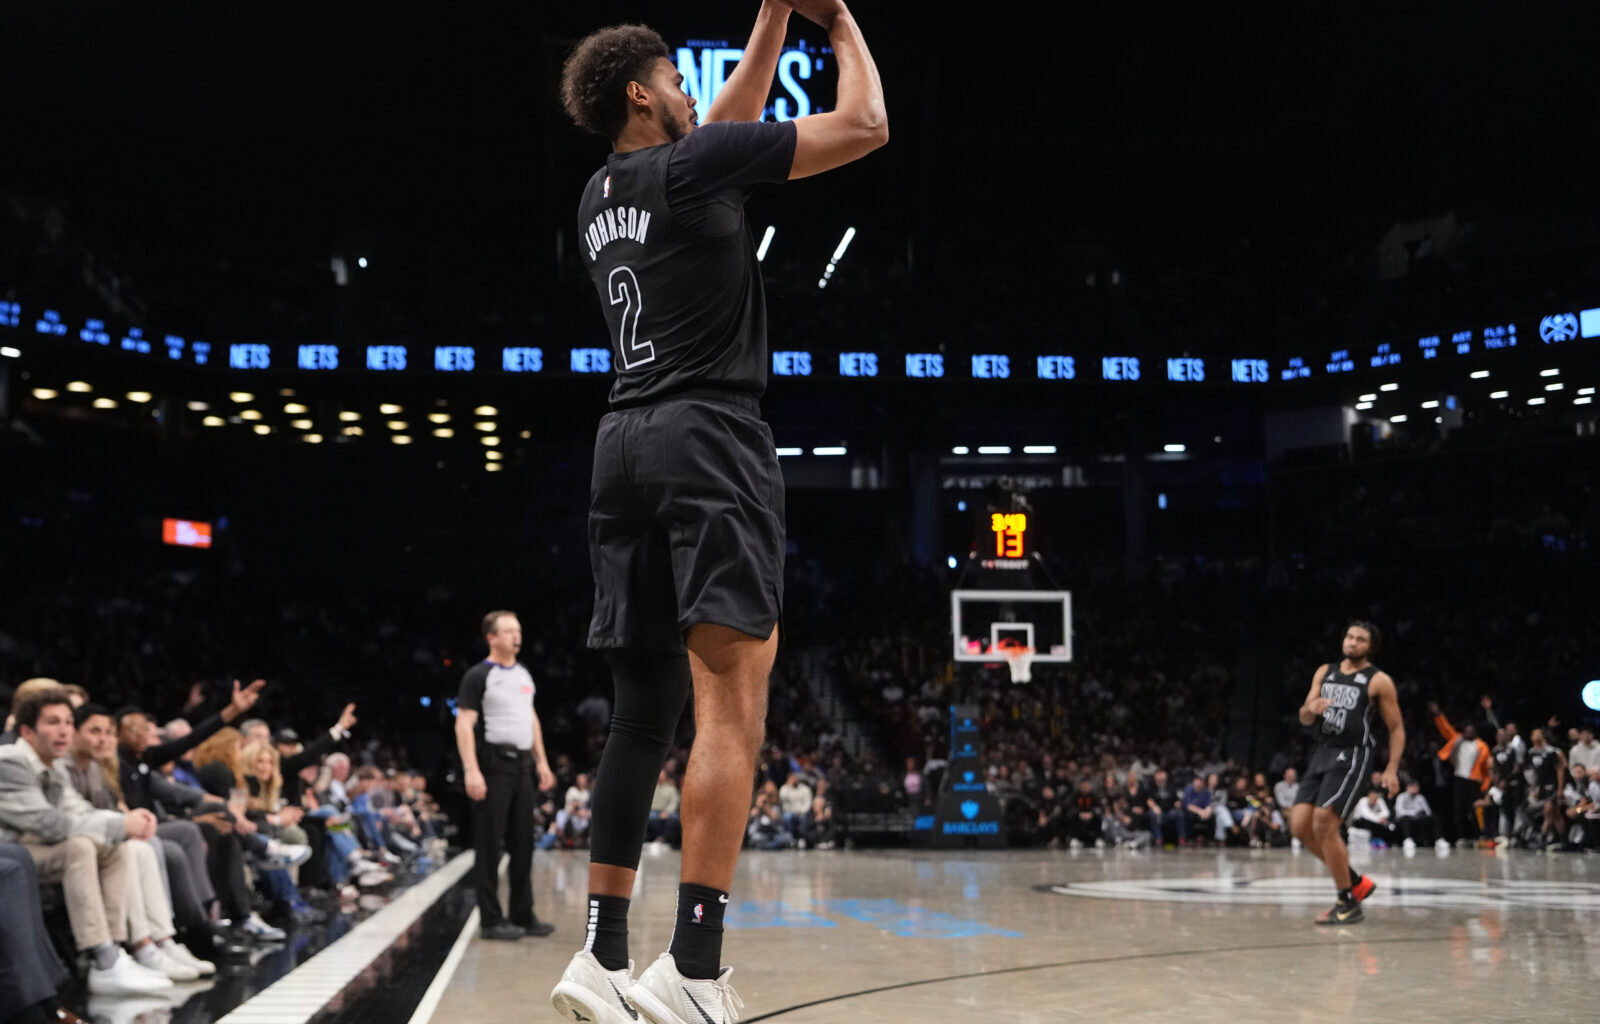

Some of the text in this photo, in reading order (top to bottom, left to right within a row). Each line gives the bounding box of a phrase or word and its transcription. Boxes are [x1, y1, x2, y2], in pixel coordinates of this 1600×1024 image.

[676, 47, 812, 125] NES
[585, 206, 651, 261] JOHNSON
[608, 265, 655, 370] 2
[229, 344, 270, 369] NETS
[298, 344, 339, 370] NETS
[366, 345, 407, 370] NETS
[435, 346, 475, 371] NETS
[502, 347, 543, 372] NETS
[571, 348, 611, 373] NETS
[773, 351, 812, 376] NETS
[839, 352, 878, 377] NETS
[905, 353, 944, 378] NETS
[972, 355, 1010, 379] NETS
[1037, 355, 1075, 380] NETS
[1102, 357, 1140, 381] NETS
[1167, 358, 1205, 382] NETS
[1232, 359, 1269, 383] NETS
[996, 528, 1024, 558] 13
[1321, 682, 1361, 711] NETS
